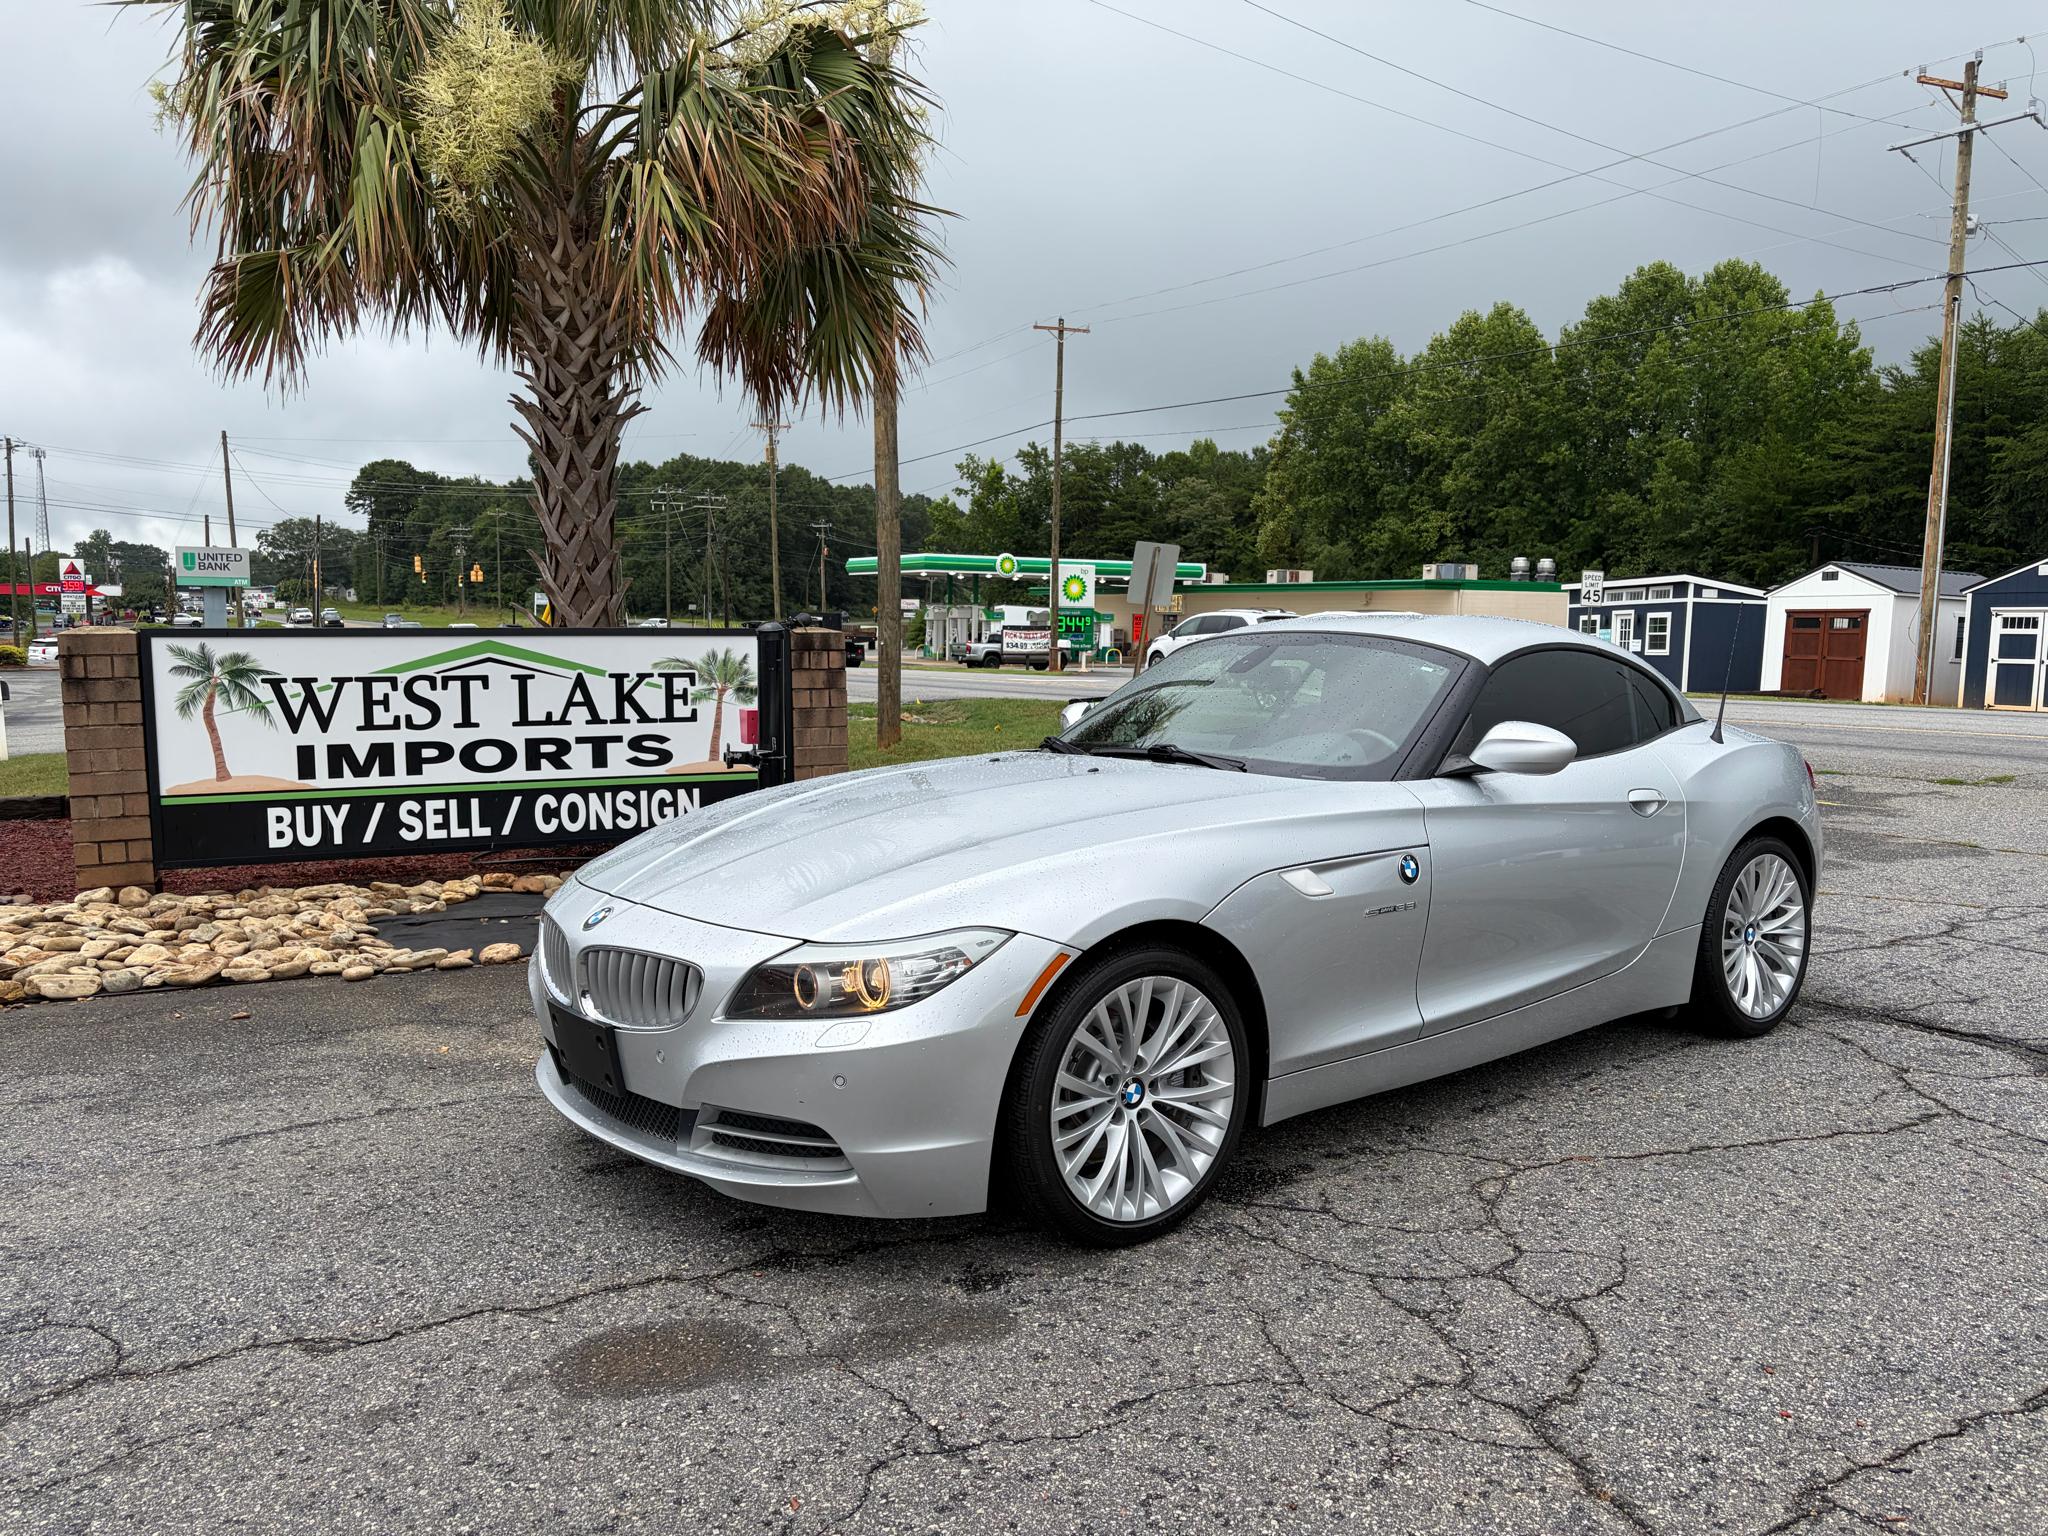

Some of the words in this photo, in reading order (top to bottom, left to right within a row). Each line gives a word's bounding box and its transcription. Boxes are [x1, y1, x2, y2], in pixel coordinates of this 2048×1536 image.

[198, 553, 243, 562] UNITED
[198, 562, 231, 571] BANK
[1582, 590, 1601, 602] 45
[260, 674, 490, 735] WEST
[510, 671, 699, 727] LAKE
[296, 733, 674, 781] IMPORTS
[266, 803, 351, 849] BUY
[362, 802, 386, 844] /
[398, 797, 492, 842] SELL
[500, 795, 523, 836] /
[534, 787, 701, 834] CONSIGN
